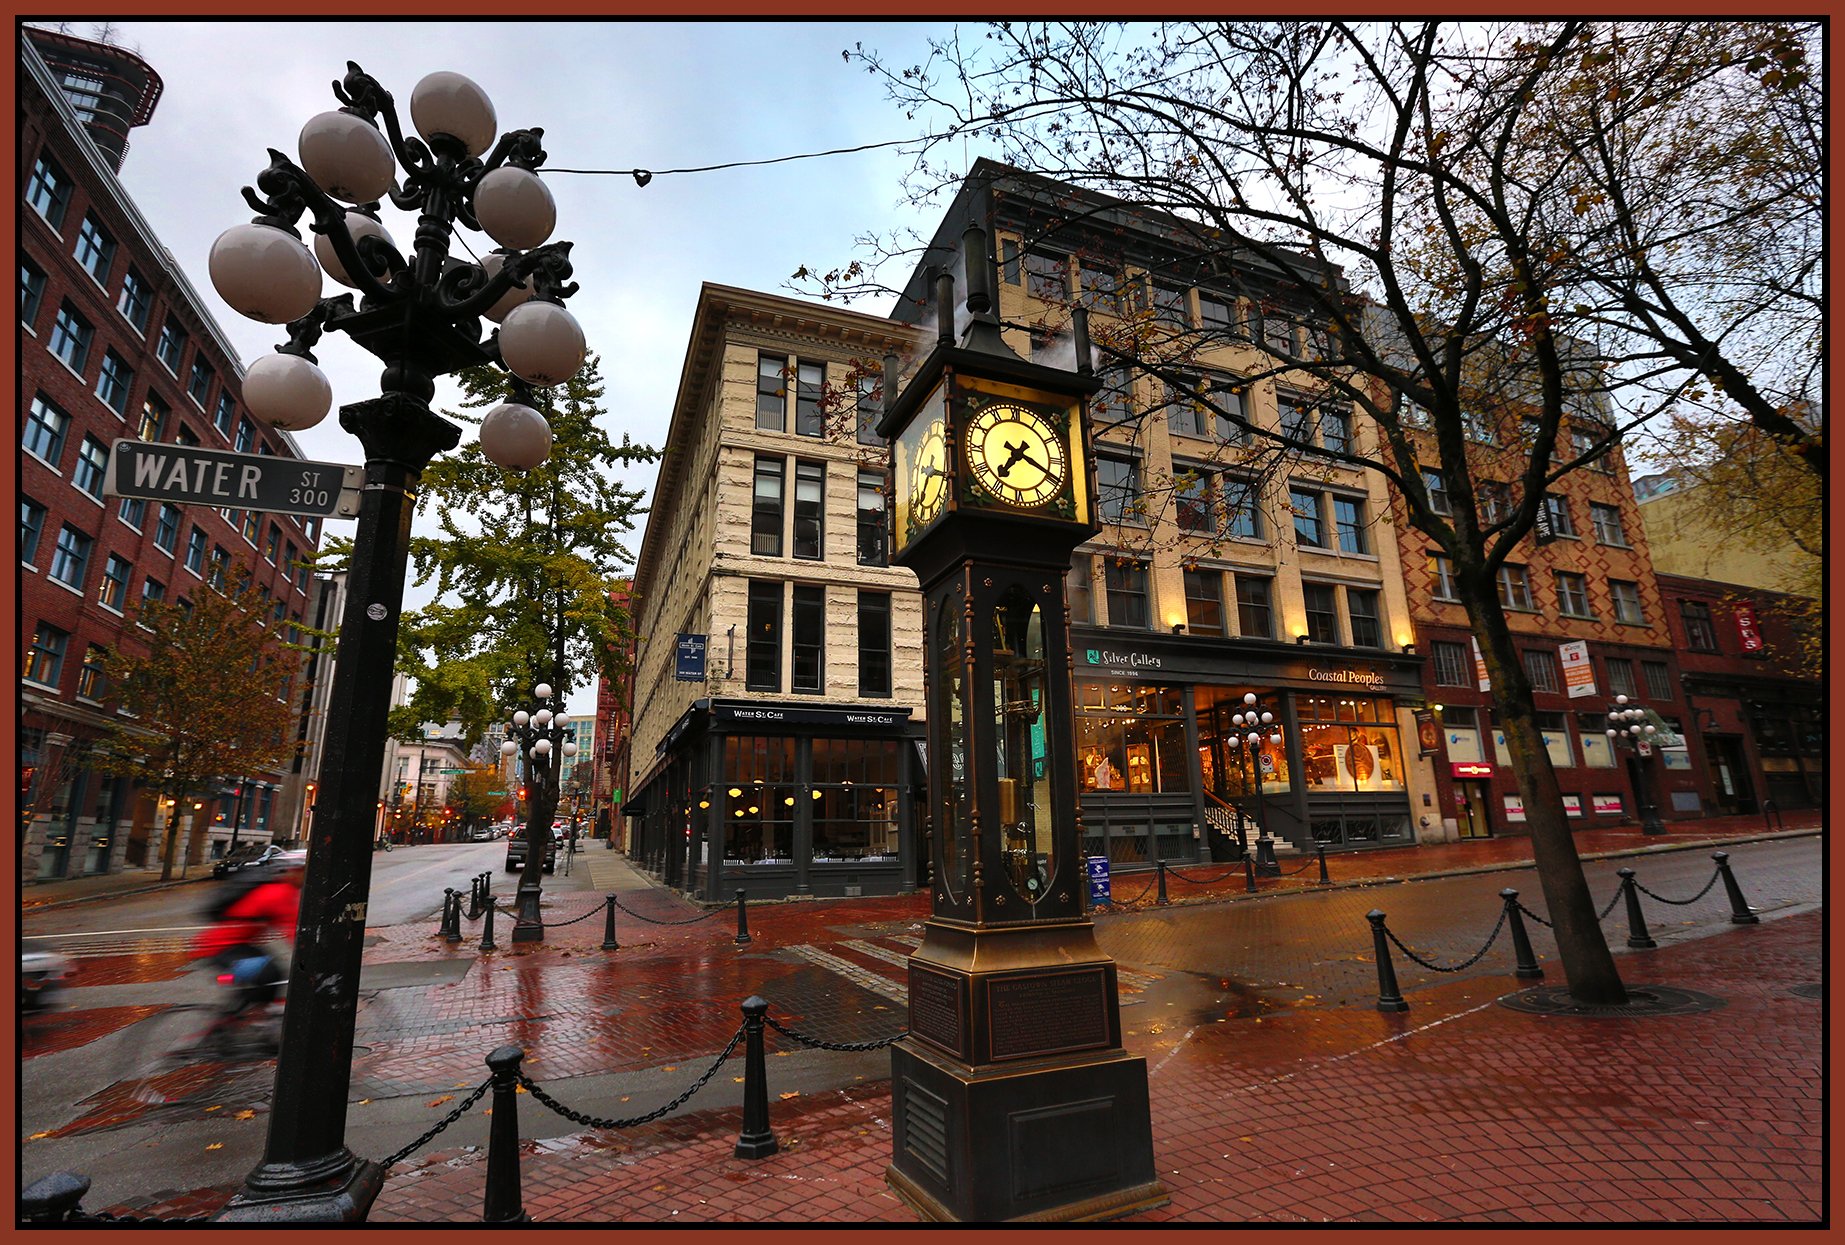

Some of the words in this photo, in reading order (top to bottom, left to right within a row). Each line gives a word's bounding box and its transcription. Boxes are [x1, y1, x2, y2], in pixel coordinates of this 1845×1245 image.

[134, 453, 262, 499] WATER
[301, 471, 321, 488] ST
[289, 488, 329, 506] 300
[1103, 651, 1128, 665] Silver
[1131, 653, 1161, 668] Gallery
[1308, 668, 1346, 683] Coastal
[1348, 671, 1384, 687] Peoples
